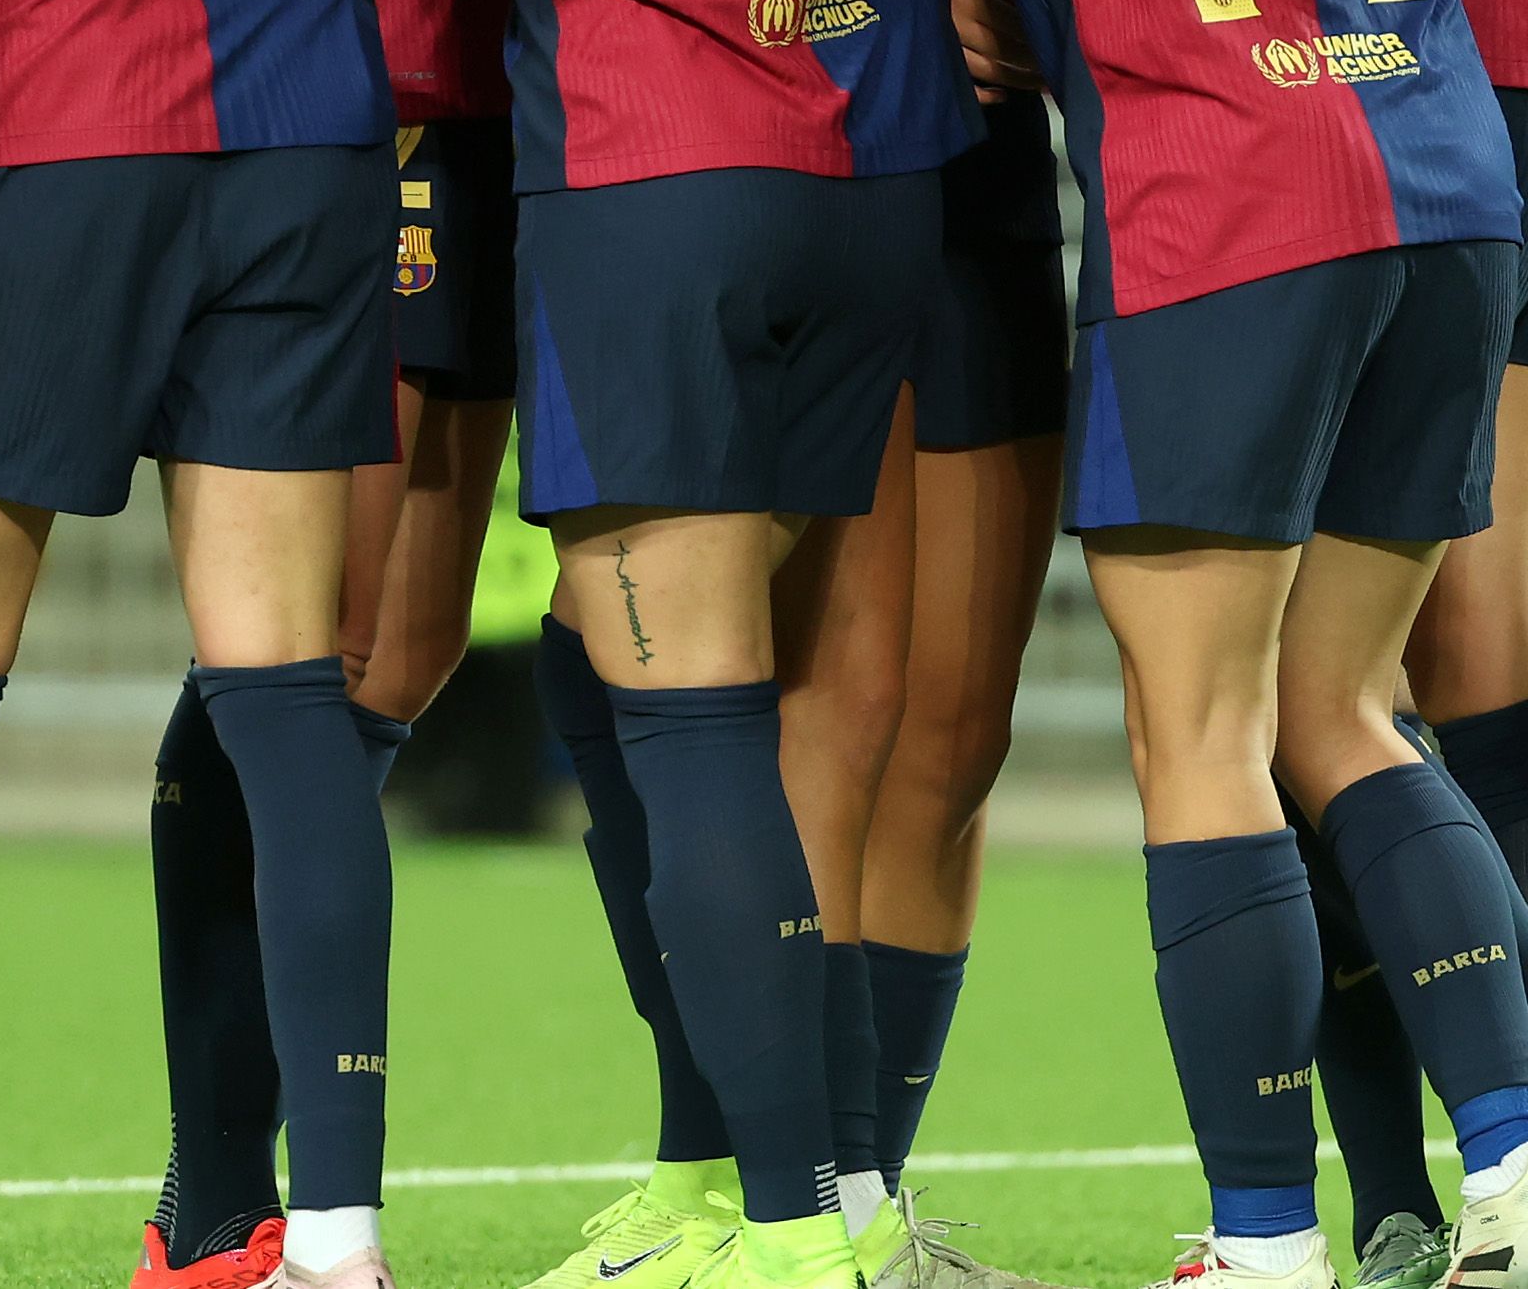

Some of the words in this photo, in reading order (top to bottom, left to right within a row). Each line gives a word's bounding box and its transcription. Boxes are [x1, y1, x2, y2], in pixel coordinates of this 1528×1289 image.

[801, 0, 876, 34] ACNUR
[1312, 32, 1406, 57] UNHCR
[1326, 49, 1419, 77] ACNUR
[1412, 944, 1507, 987] BARÇA
